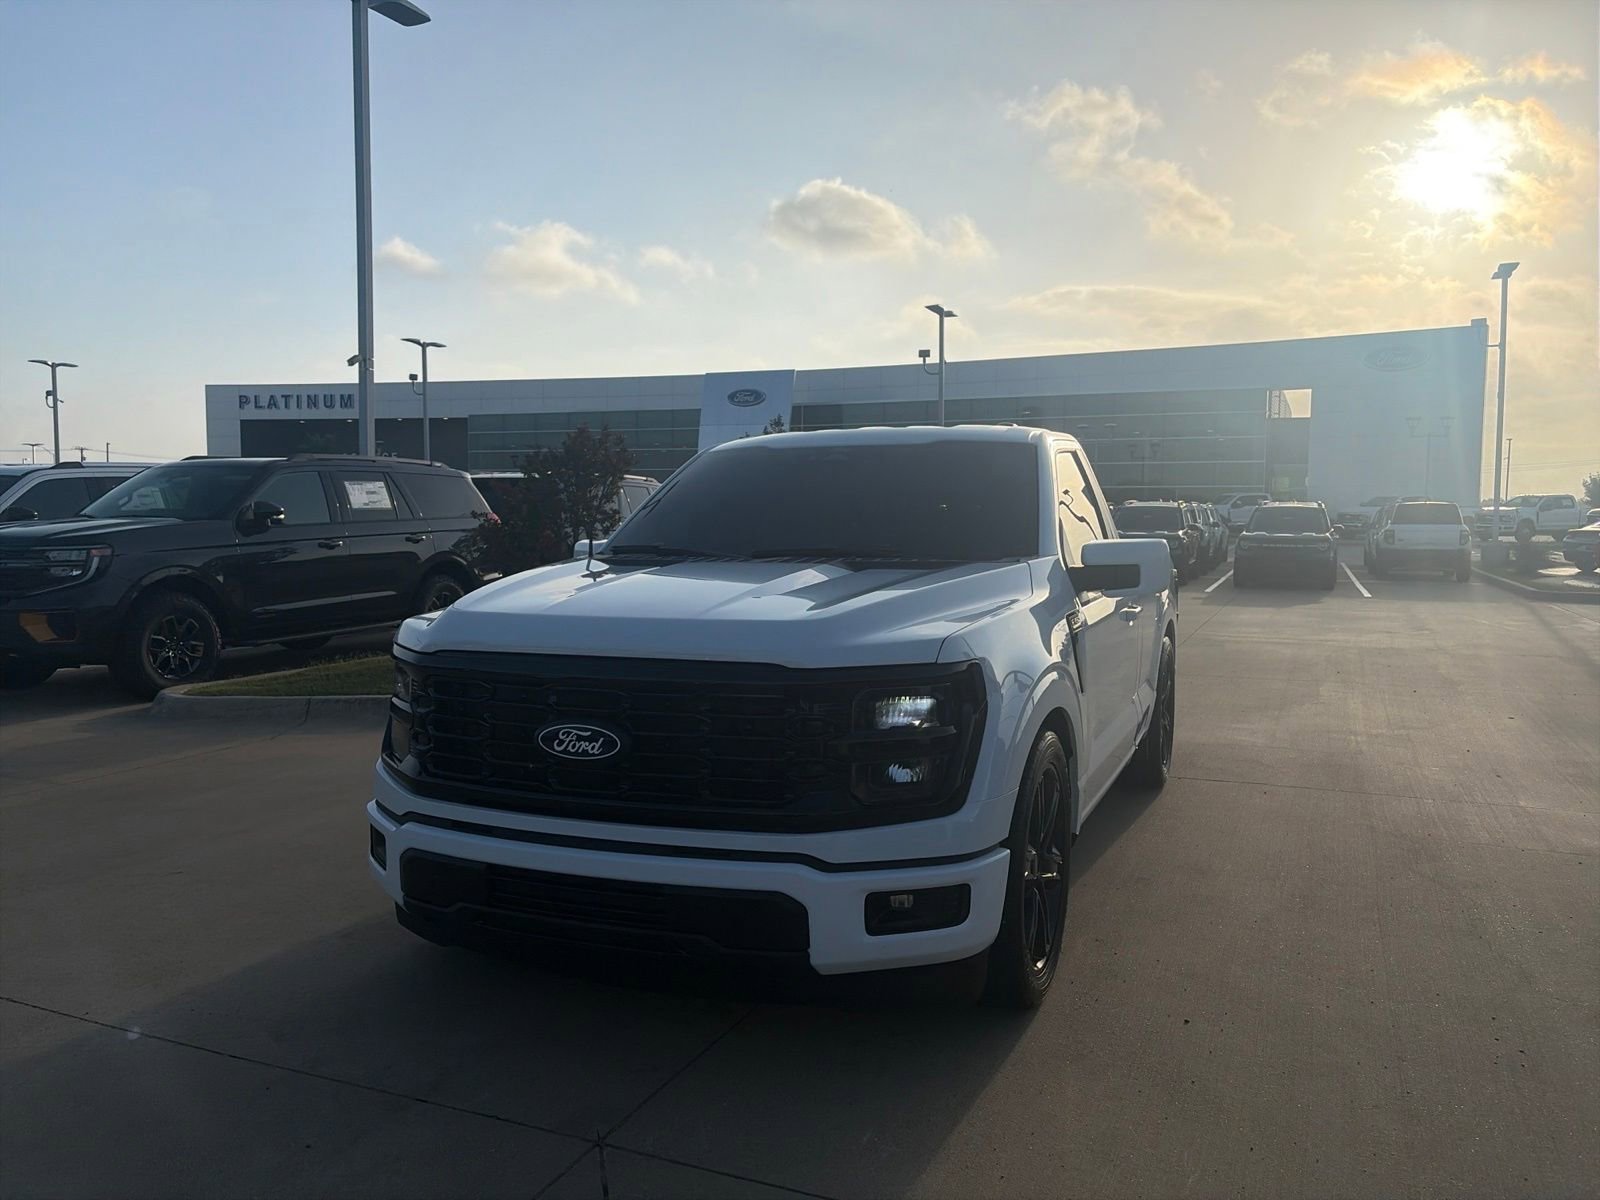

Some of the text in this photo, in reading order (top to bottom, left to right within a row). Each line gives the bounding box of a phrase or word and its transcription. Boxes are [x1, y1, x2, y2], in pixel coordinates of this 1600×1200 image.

[238, 393, 355, 410] PLATINUM
[733, 391, 756, 402] Ford
[553, 728, 604, 755] Ford
